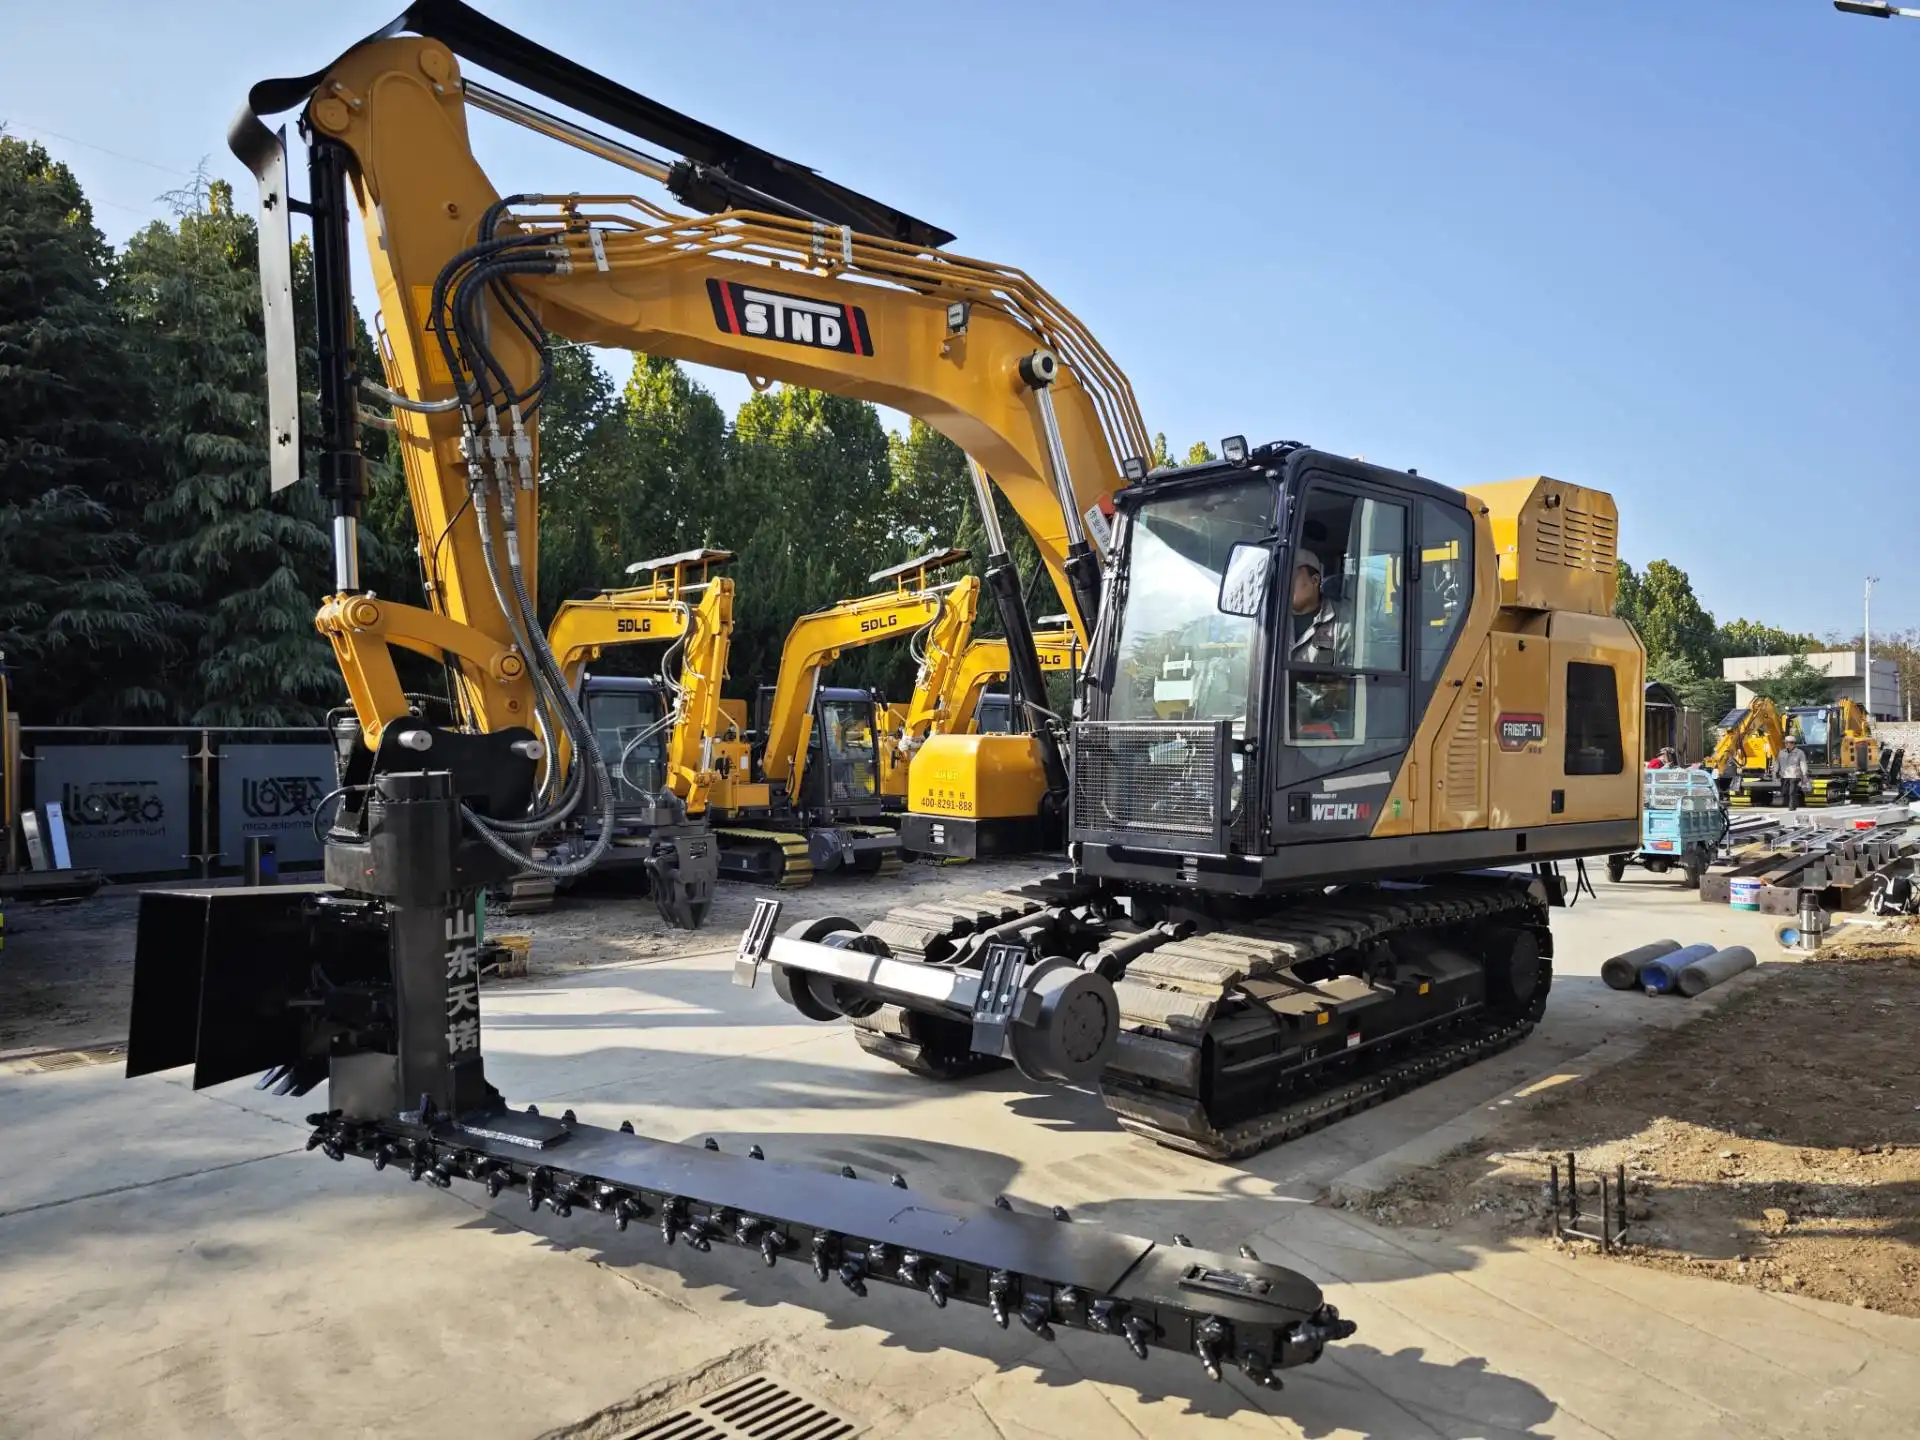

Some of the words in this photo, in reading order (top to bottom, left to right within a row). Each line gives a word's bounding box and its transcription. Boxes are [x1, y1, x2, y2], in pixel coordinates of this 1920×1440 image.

[743, 289, 841, 346] STND
[617, 618, 651, 632] SDLG
[860, 614, 897, 632] SDLG
[1037, 654, 1061, 665] DLG
[444, 908, 479, 1054] 山东天诺
